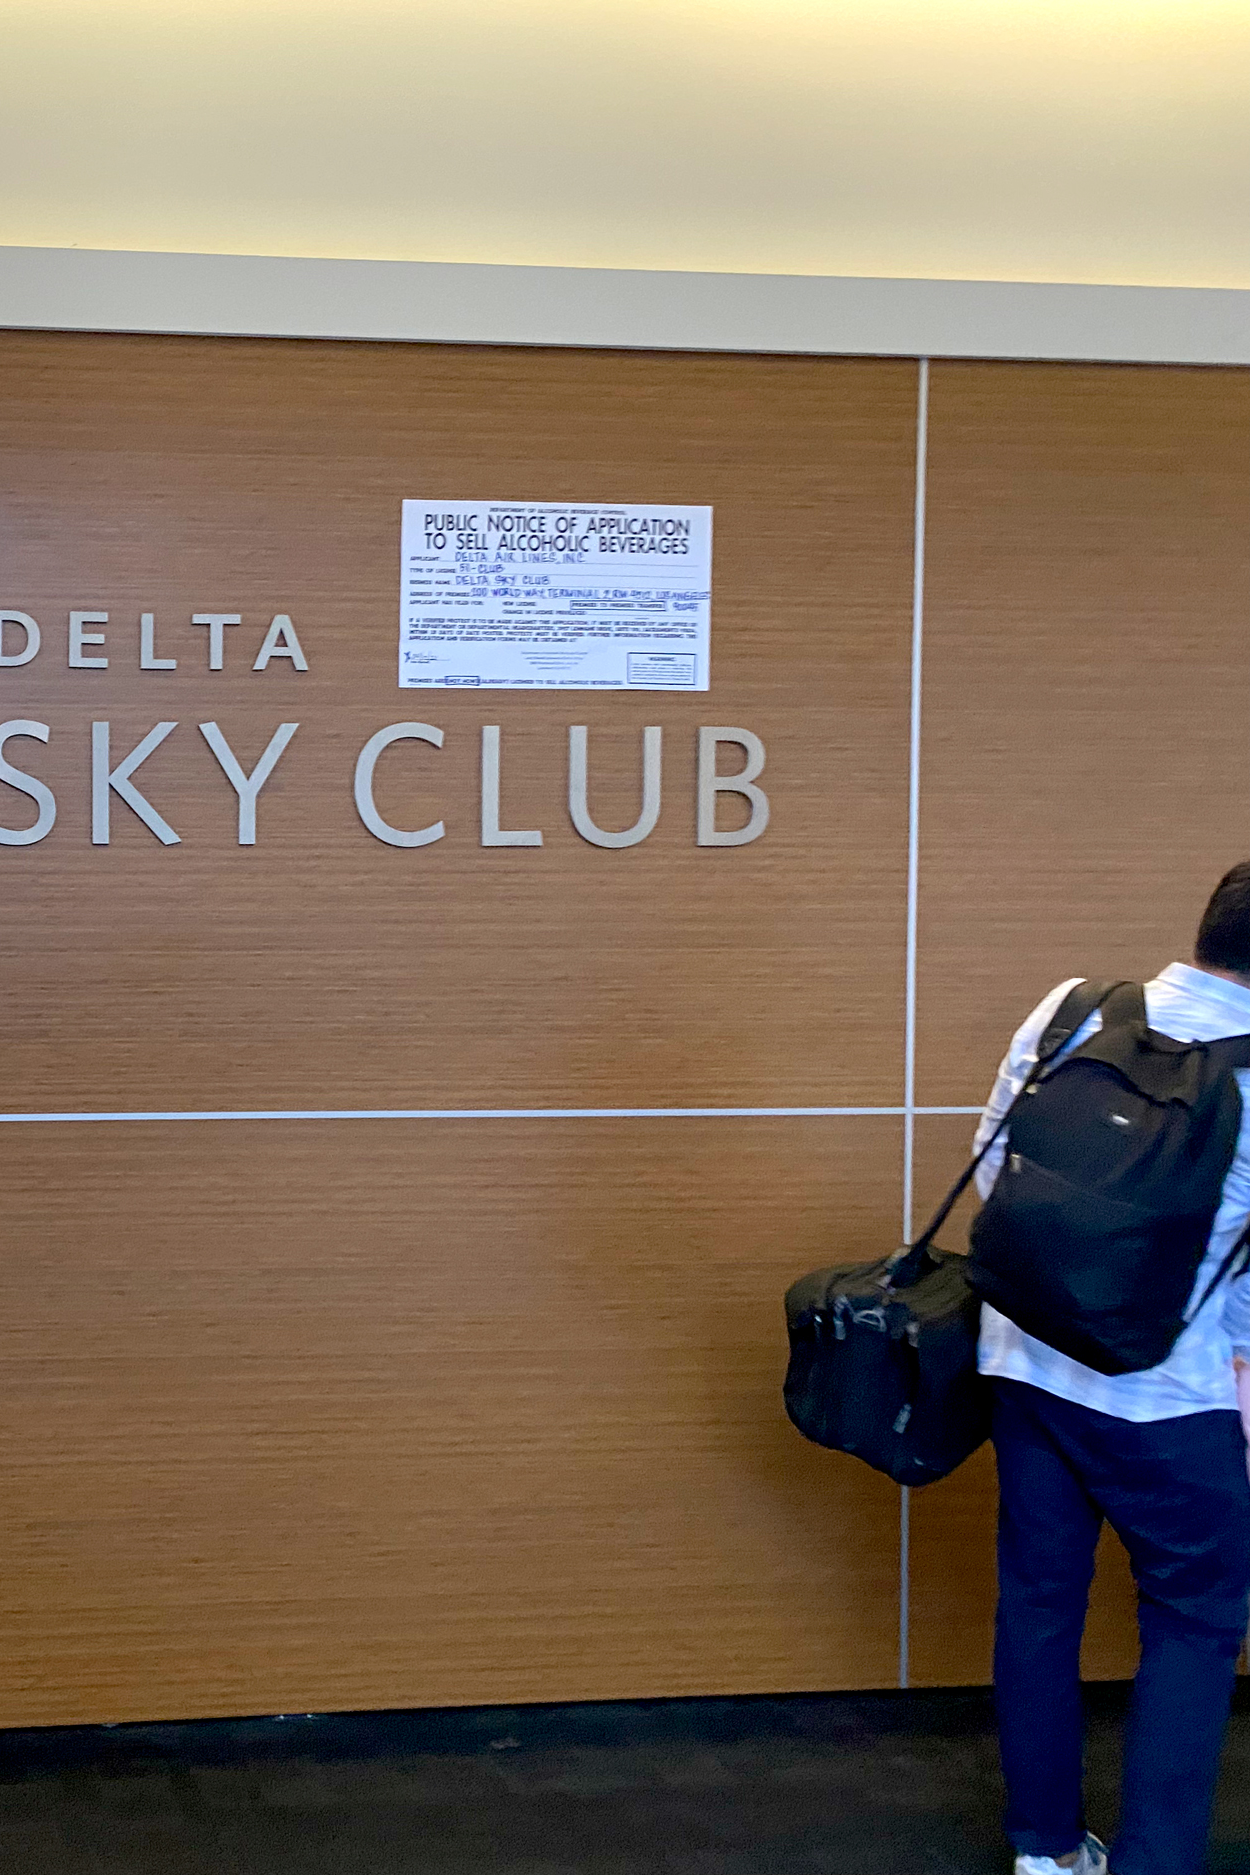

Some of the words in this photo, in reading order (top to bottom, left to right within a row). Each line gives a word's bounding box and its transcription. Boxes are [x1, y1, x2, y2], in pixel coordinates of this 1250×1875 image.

[424, 514, 478, 531] PUBLIC
[487, 515, 547, 533] NOTICE
[555, 516, 579, 533] OF
[586, 517, 690, 536] APPLICATION
[424, 532, 447, 549] TO
[456, 533, 488, 550] SELL
[496, 533, 590, 552] ALCOHOLIC
[599, 536, 689, 554] BEVERAGES
[454, 551, 488, 562] DELTA
[494, 551, 516, 563] AIR
[455, 575, 490, 586] DELTA
[494, 575, 516, 586] SKY
[522, 576, 550, 586] CLUB
[492, 588, 521, 598] WORLD
[548, 588, 599, 599] TERMINAL
[354, 721, 771, 850] CLUB
